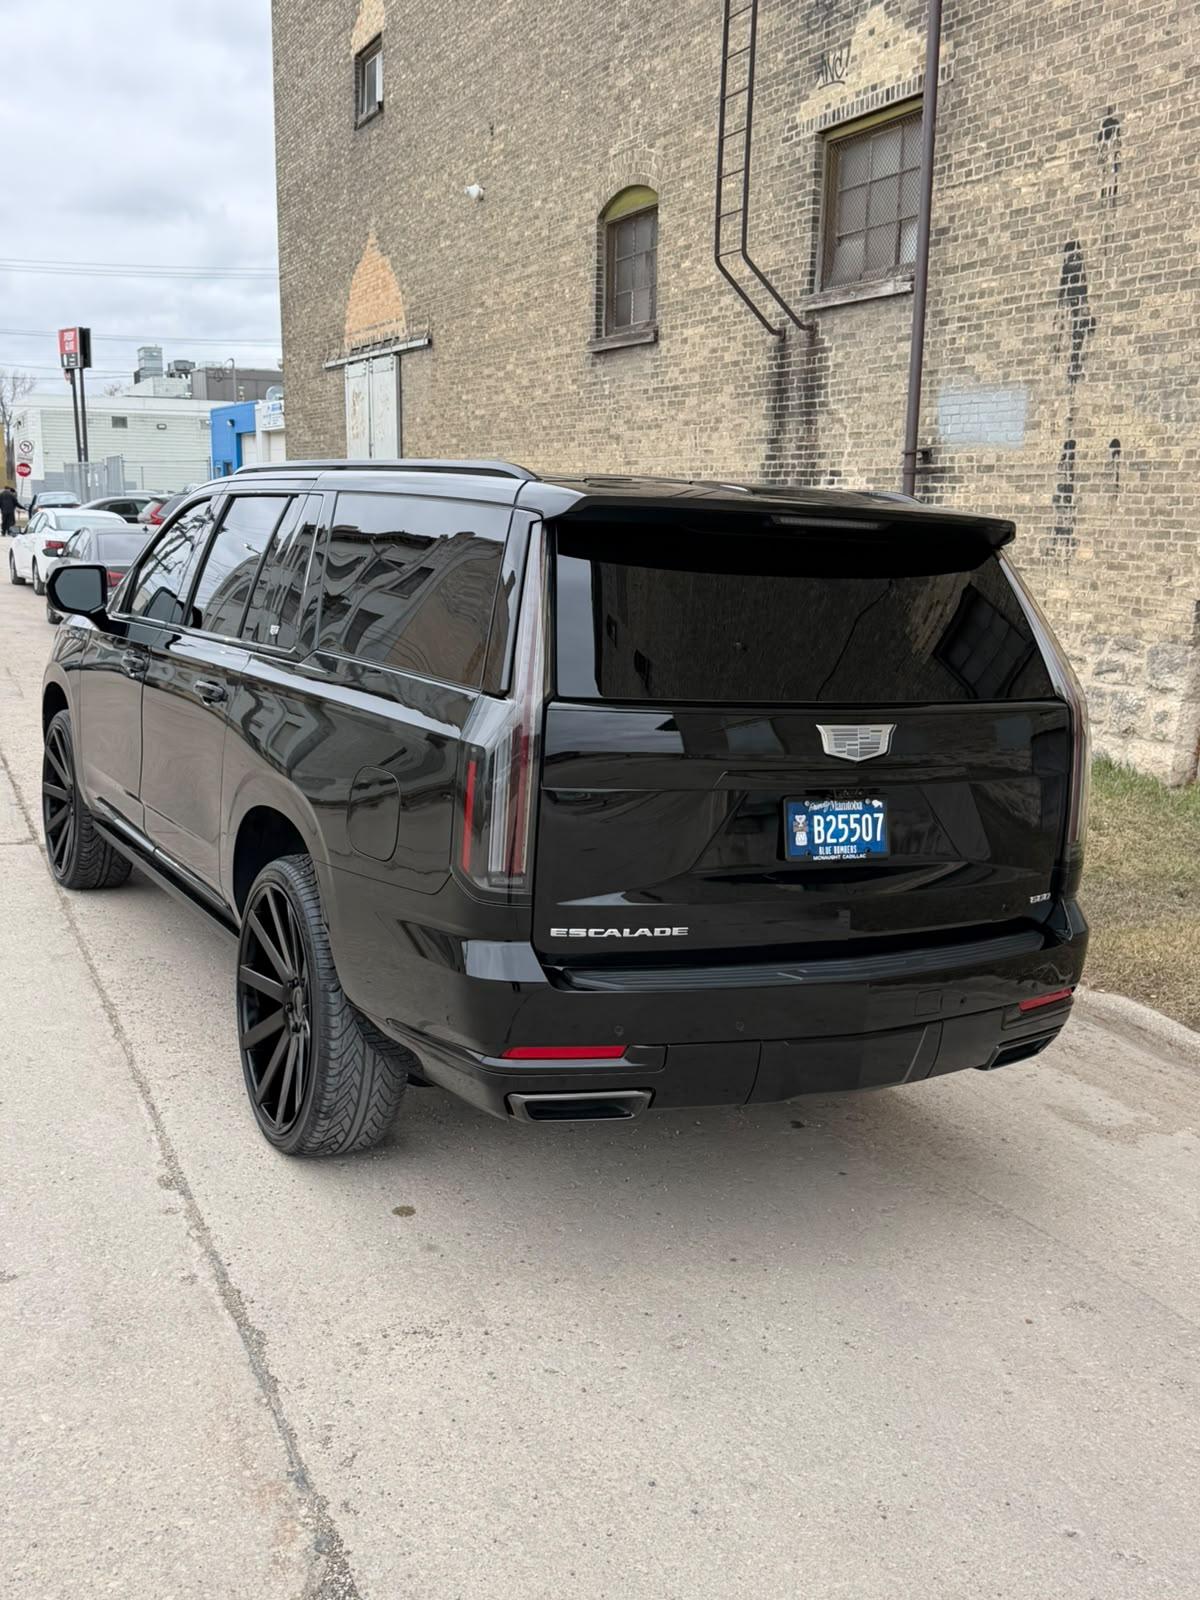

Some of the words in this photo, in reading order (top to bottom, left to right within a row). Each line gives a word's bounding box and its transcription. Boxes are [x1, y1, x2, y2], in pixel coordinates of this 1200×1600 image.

[829, 800, 863, 811] Manitoba
[813, 813, 884, 844] B25507
[819, 846, 832, 855] BLUE
[550, 927, 689, 938] ESCALADE
